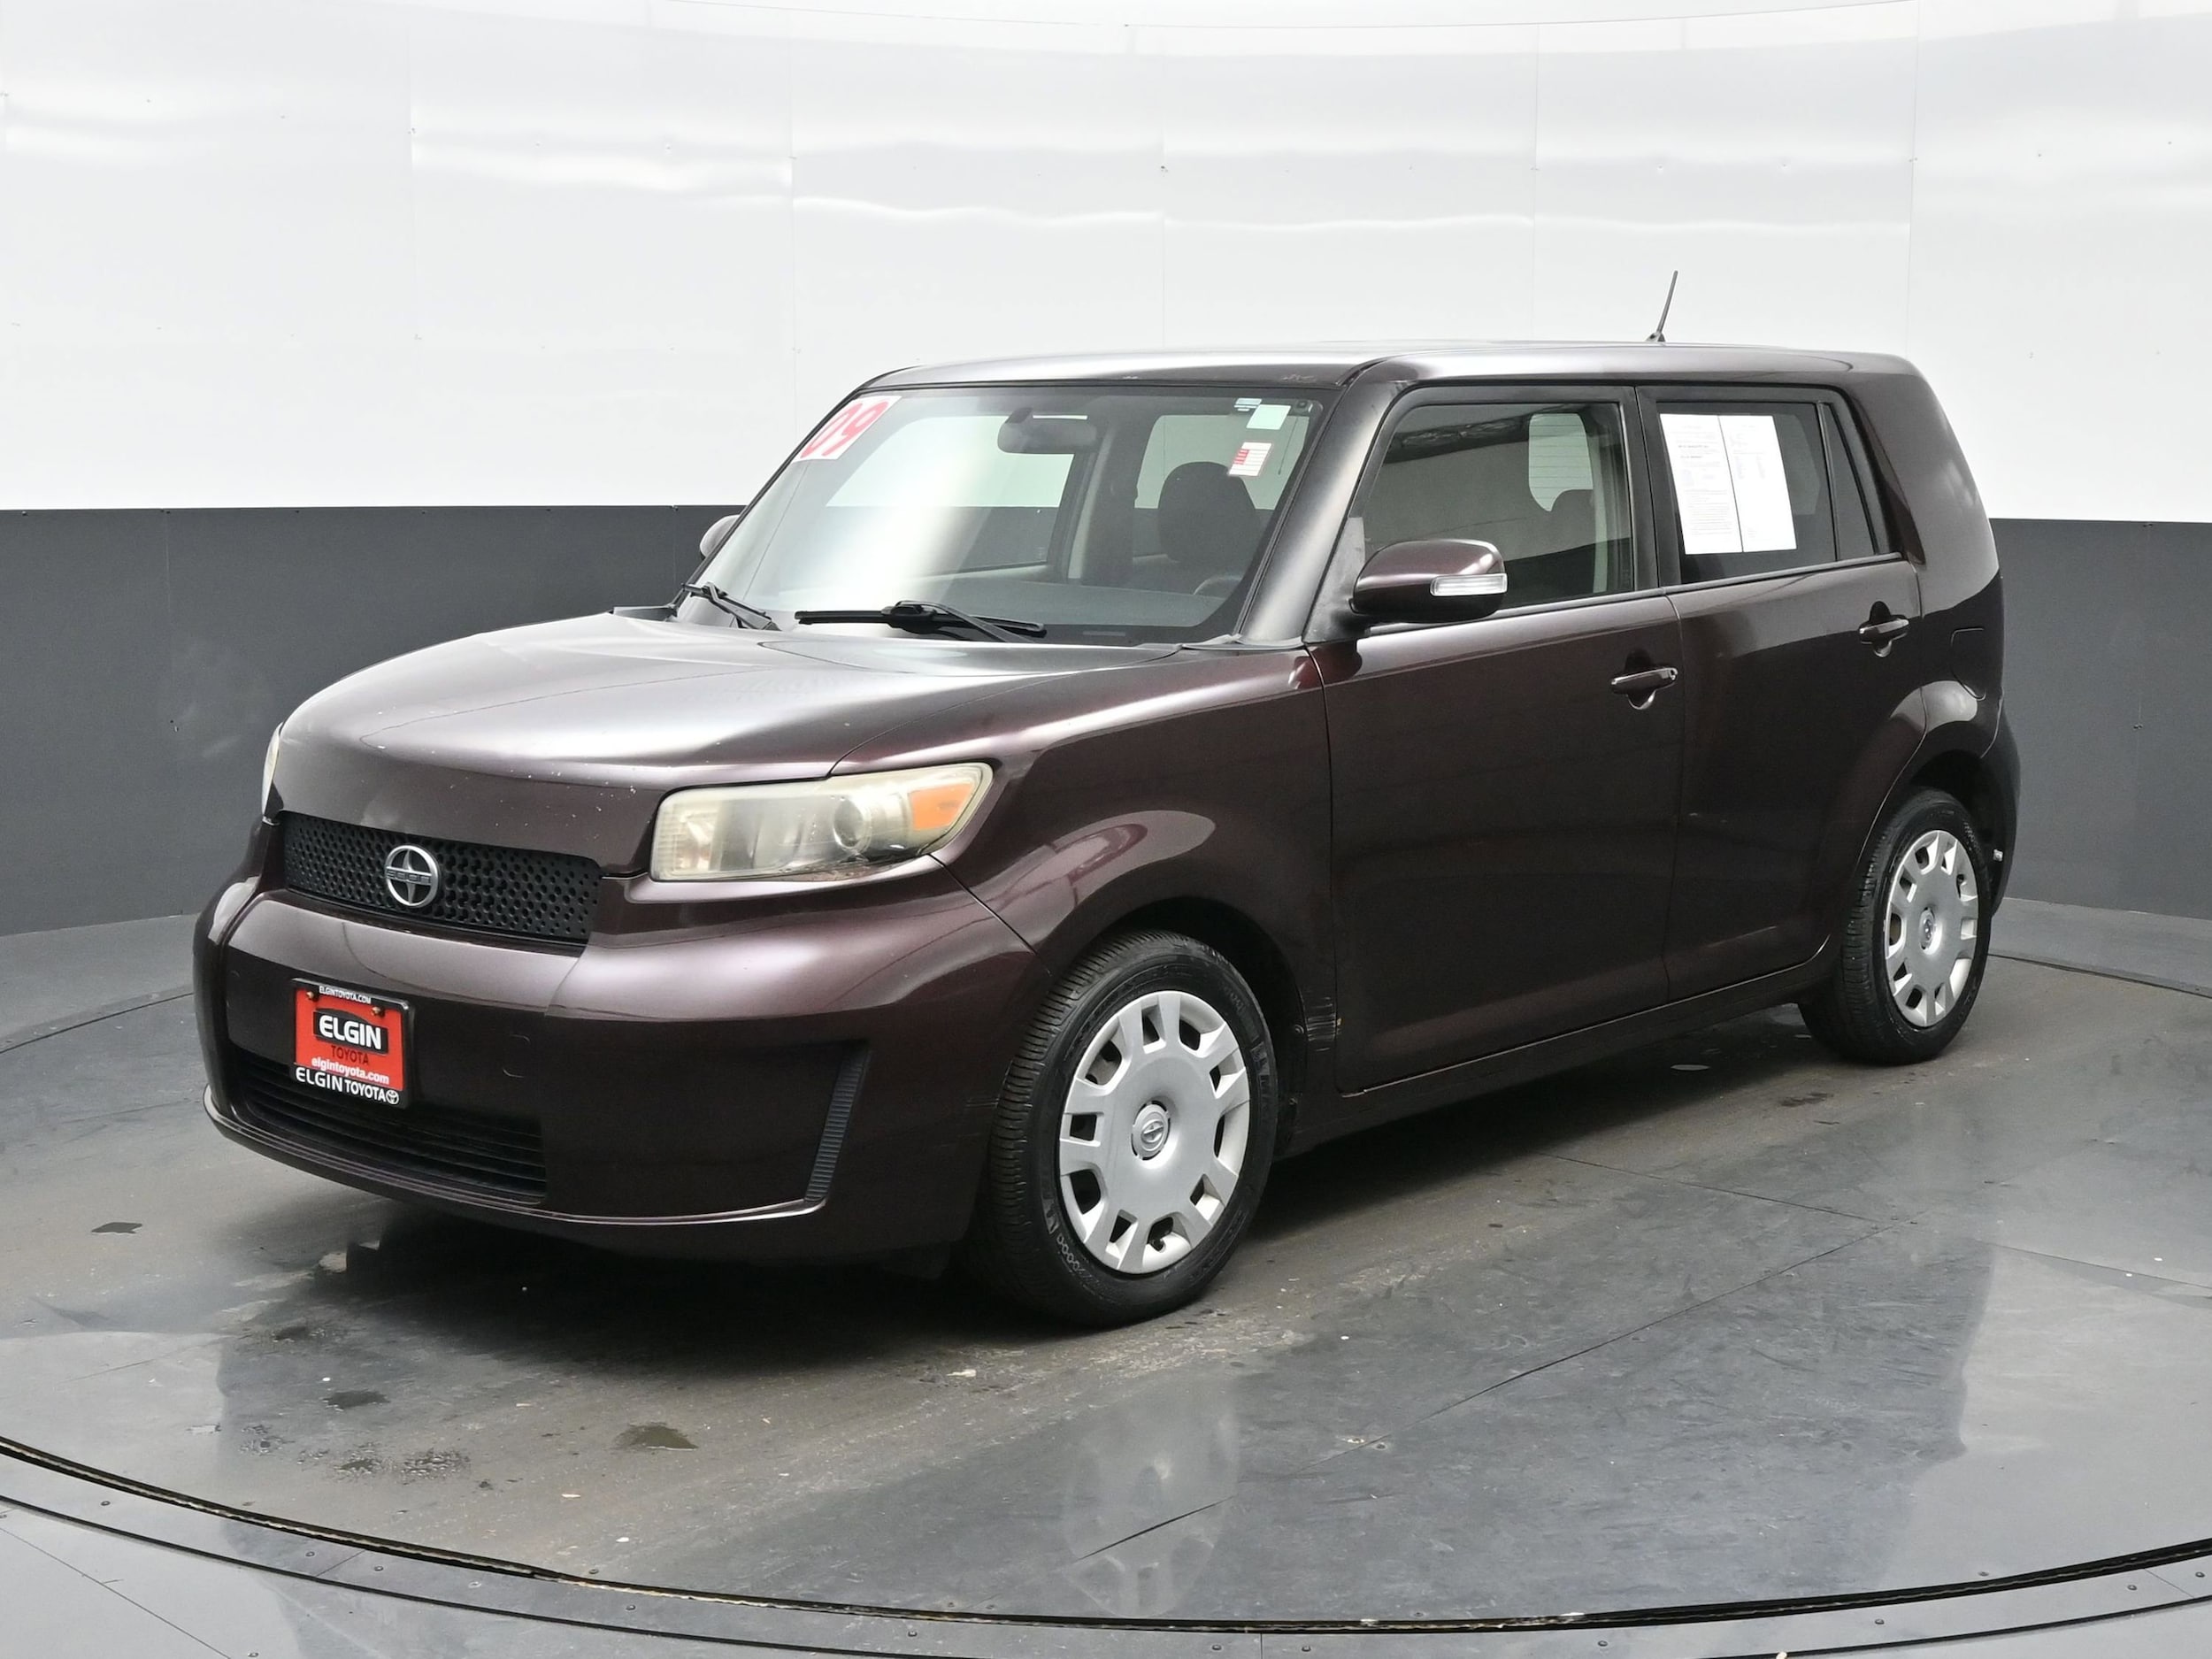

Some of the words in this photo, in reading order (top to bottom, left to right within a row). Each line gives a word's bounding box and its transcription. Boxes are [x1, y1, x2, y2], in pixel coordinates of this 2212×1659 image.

[800, 400, 889, 459] 09
[319, 985, 372, 1004] ELGINTOYOTA.COM
[319, 1014, 381, 1050] ELGIN
[311, 1056, 389, 1085] elgintoyota.com
[331, 1045, 369, 1065] TOYOTA
[296, 1066, 342, 1093] ELGIN
[344, 1079, 387, 1102] TOYOTA
